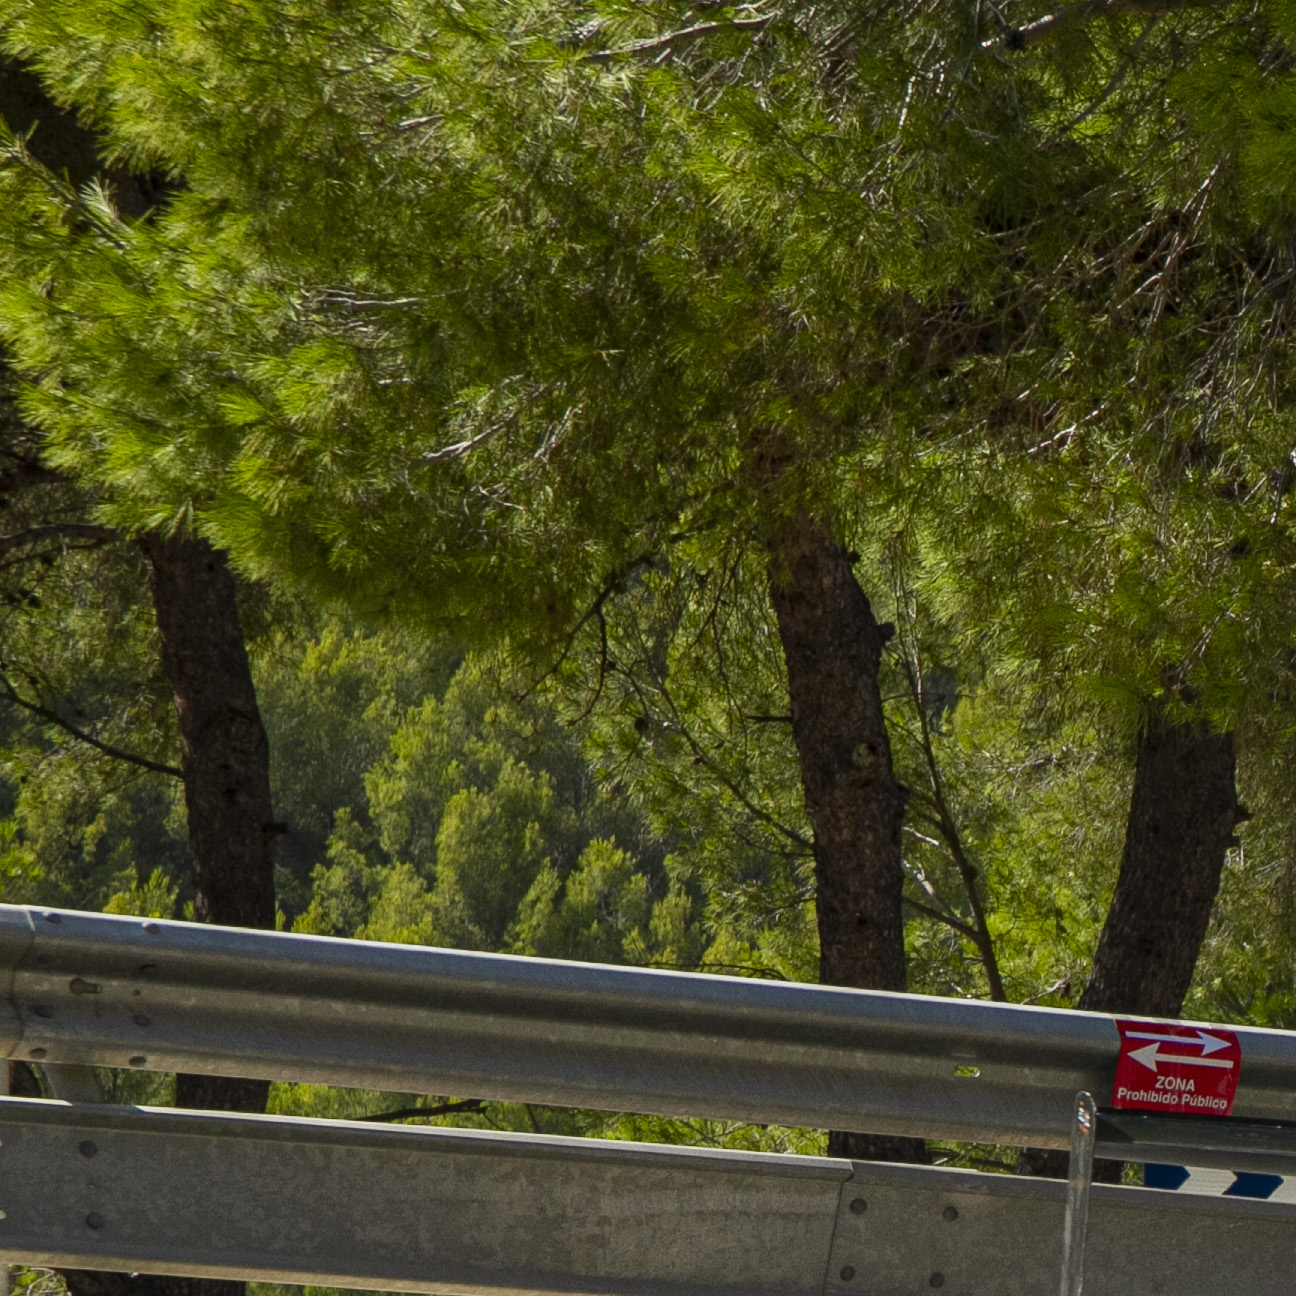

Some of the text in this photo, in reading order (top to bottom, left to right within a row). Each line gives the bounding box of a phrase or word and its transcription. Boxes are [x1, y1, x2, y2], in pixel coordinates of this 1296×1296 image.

[1155, 1076, 1195, 1091] ZONA
[1117, 1087, 1228, 1110] Prohibido Público
